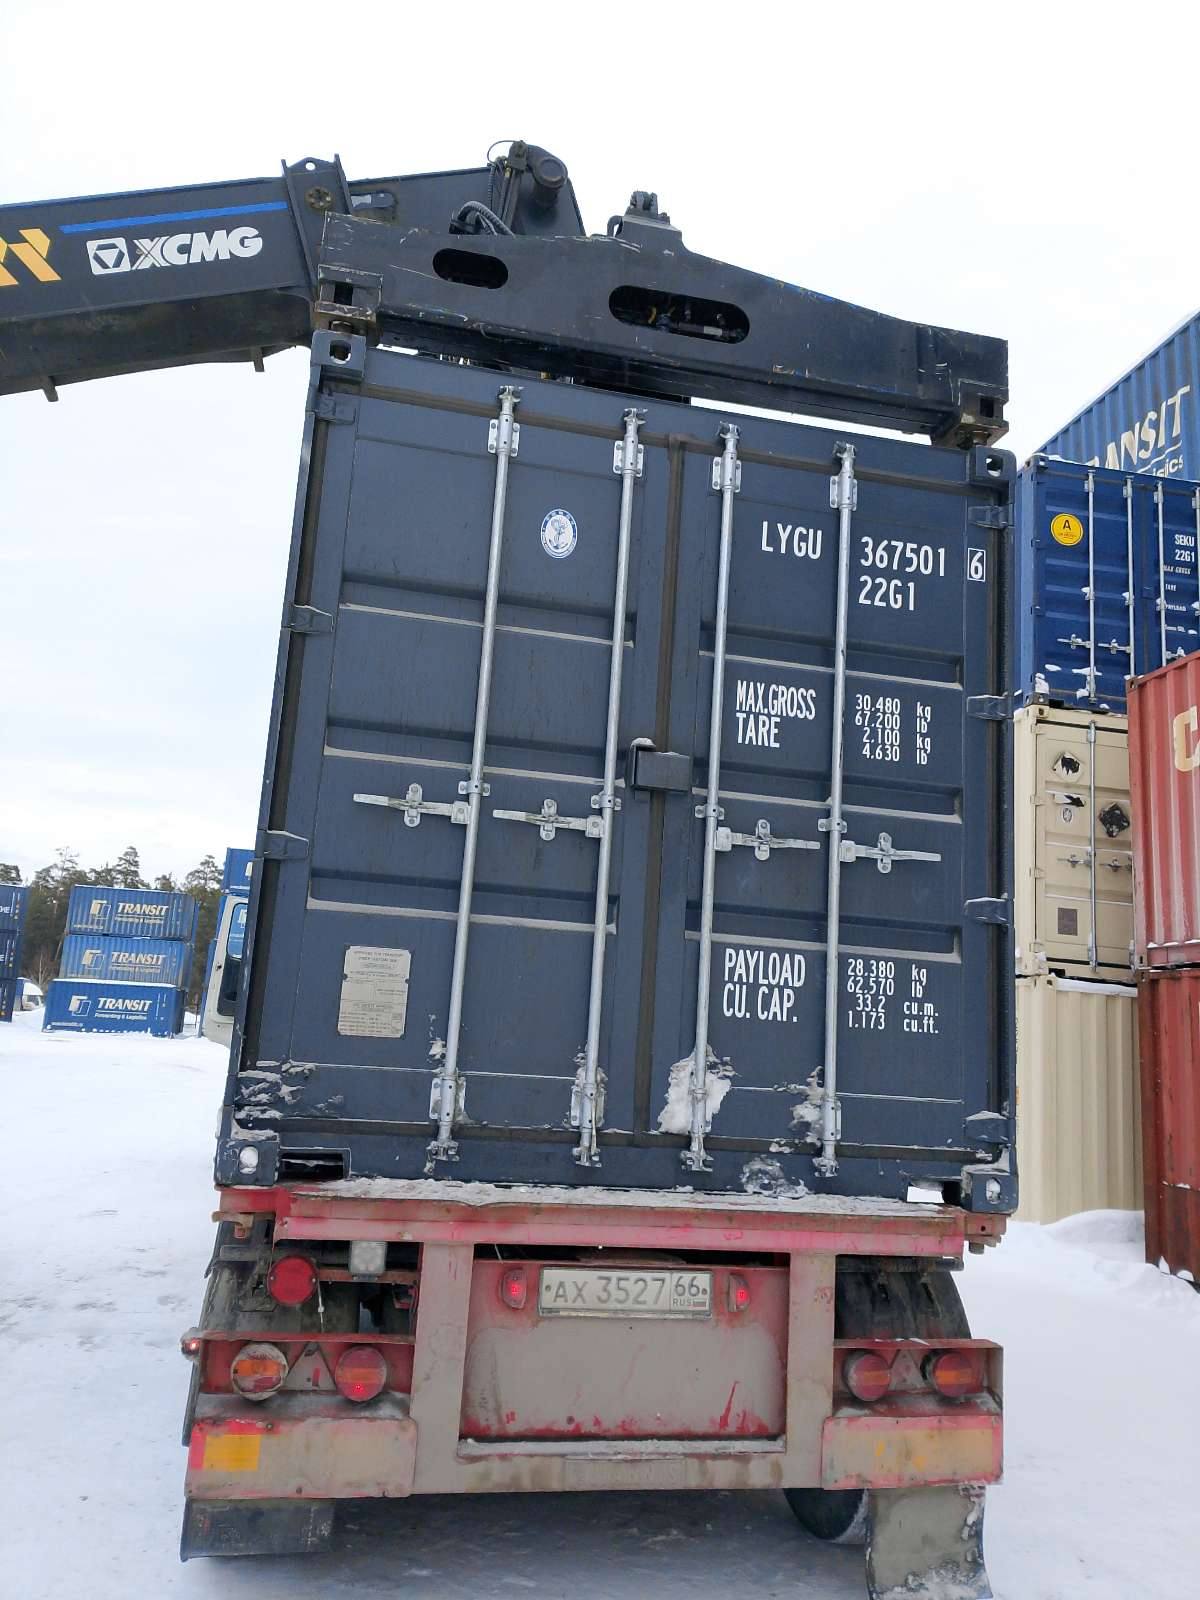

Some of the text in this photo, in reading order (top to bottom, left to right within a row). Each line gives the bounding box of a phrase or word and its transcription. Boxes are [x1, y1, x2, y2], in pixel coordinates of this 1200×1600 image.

[131, 226, 262, 270] XCMG
[761, 520, 983, 579] LYGU 367501 6
[1174, 534, 1195, 547] SEKU
[1175, 549, 1195, 562] 22G1
[858, 575, 915, 611] 22G1
[855, 694, 900, 714] 30.480
[916, 702, 931, 722] kg
[735, 712, 931, 753] TARE 2.100 kg
[855, 711, 928, 734] 67.200 lb
[862, 743, 928, 765] 4.630 lb
[117, 902, 169, 916] TRANSIT
[111, 952, 166, 965] TRANSIT
[724, 948, 927, 987] PAYLOAD 28.380 kg
[847, 976, 923, 998] 62.570 lb
[97, 998, 152, 1012] TRANSIT
[723, 983, 750, 1019] CU.
[757, 986, 798, 1023] CAP.
[855, 994, 886, 1013] 33.2
[848, 1010, 885, 1030] 1.173
[553, 1275, 700, 1305] AX 3527 66
